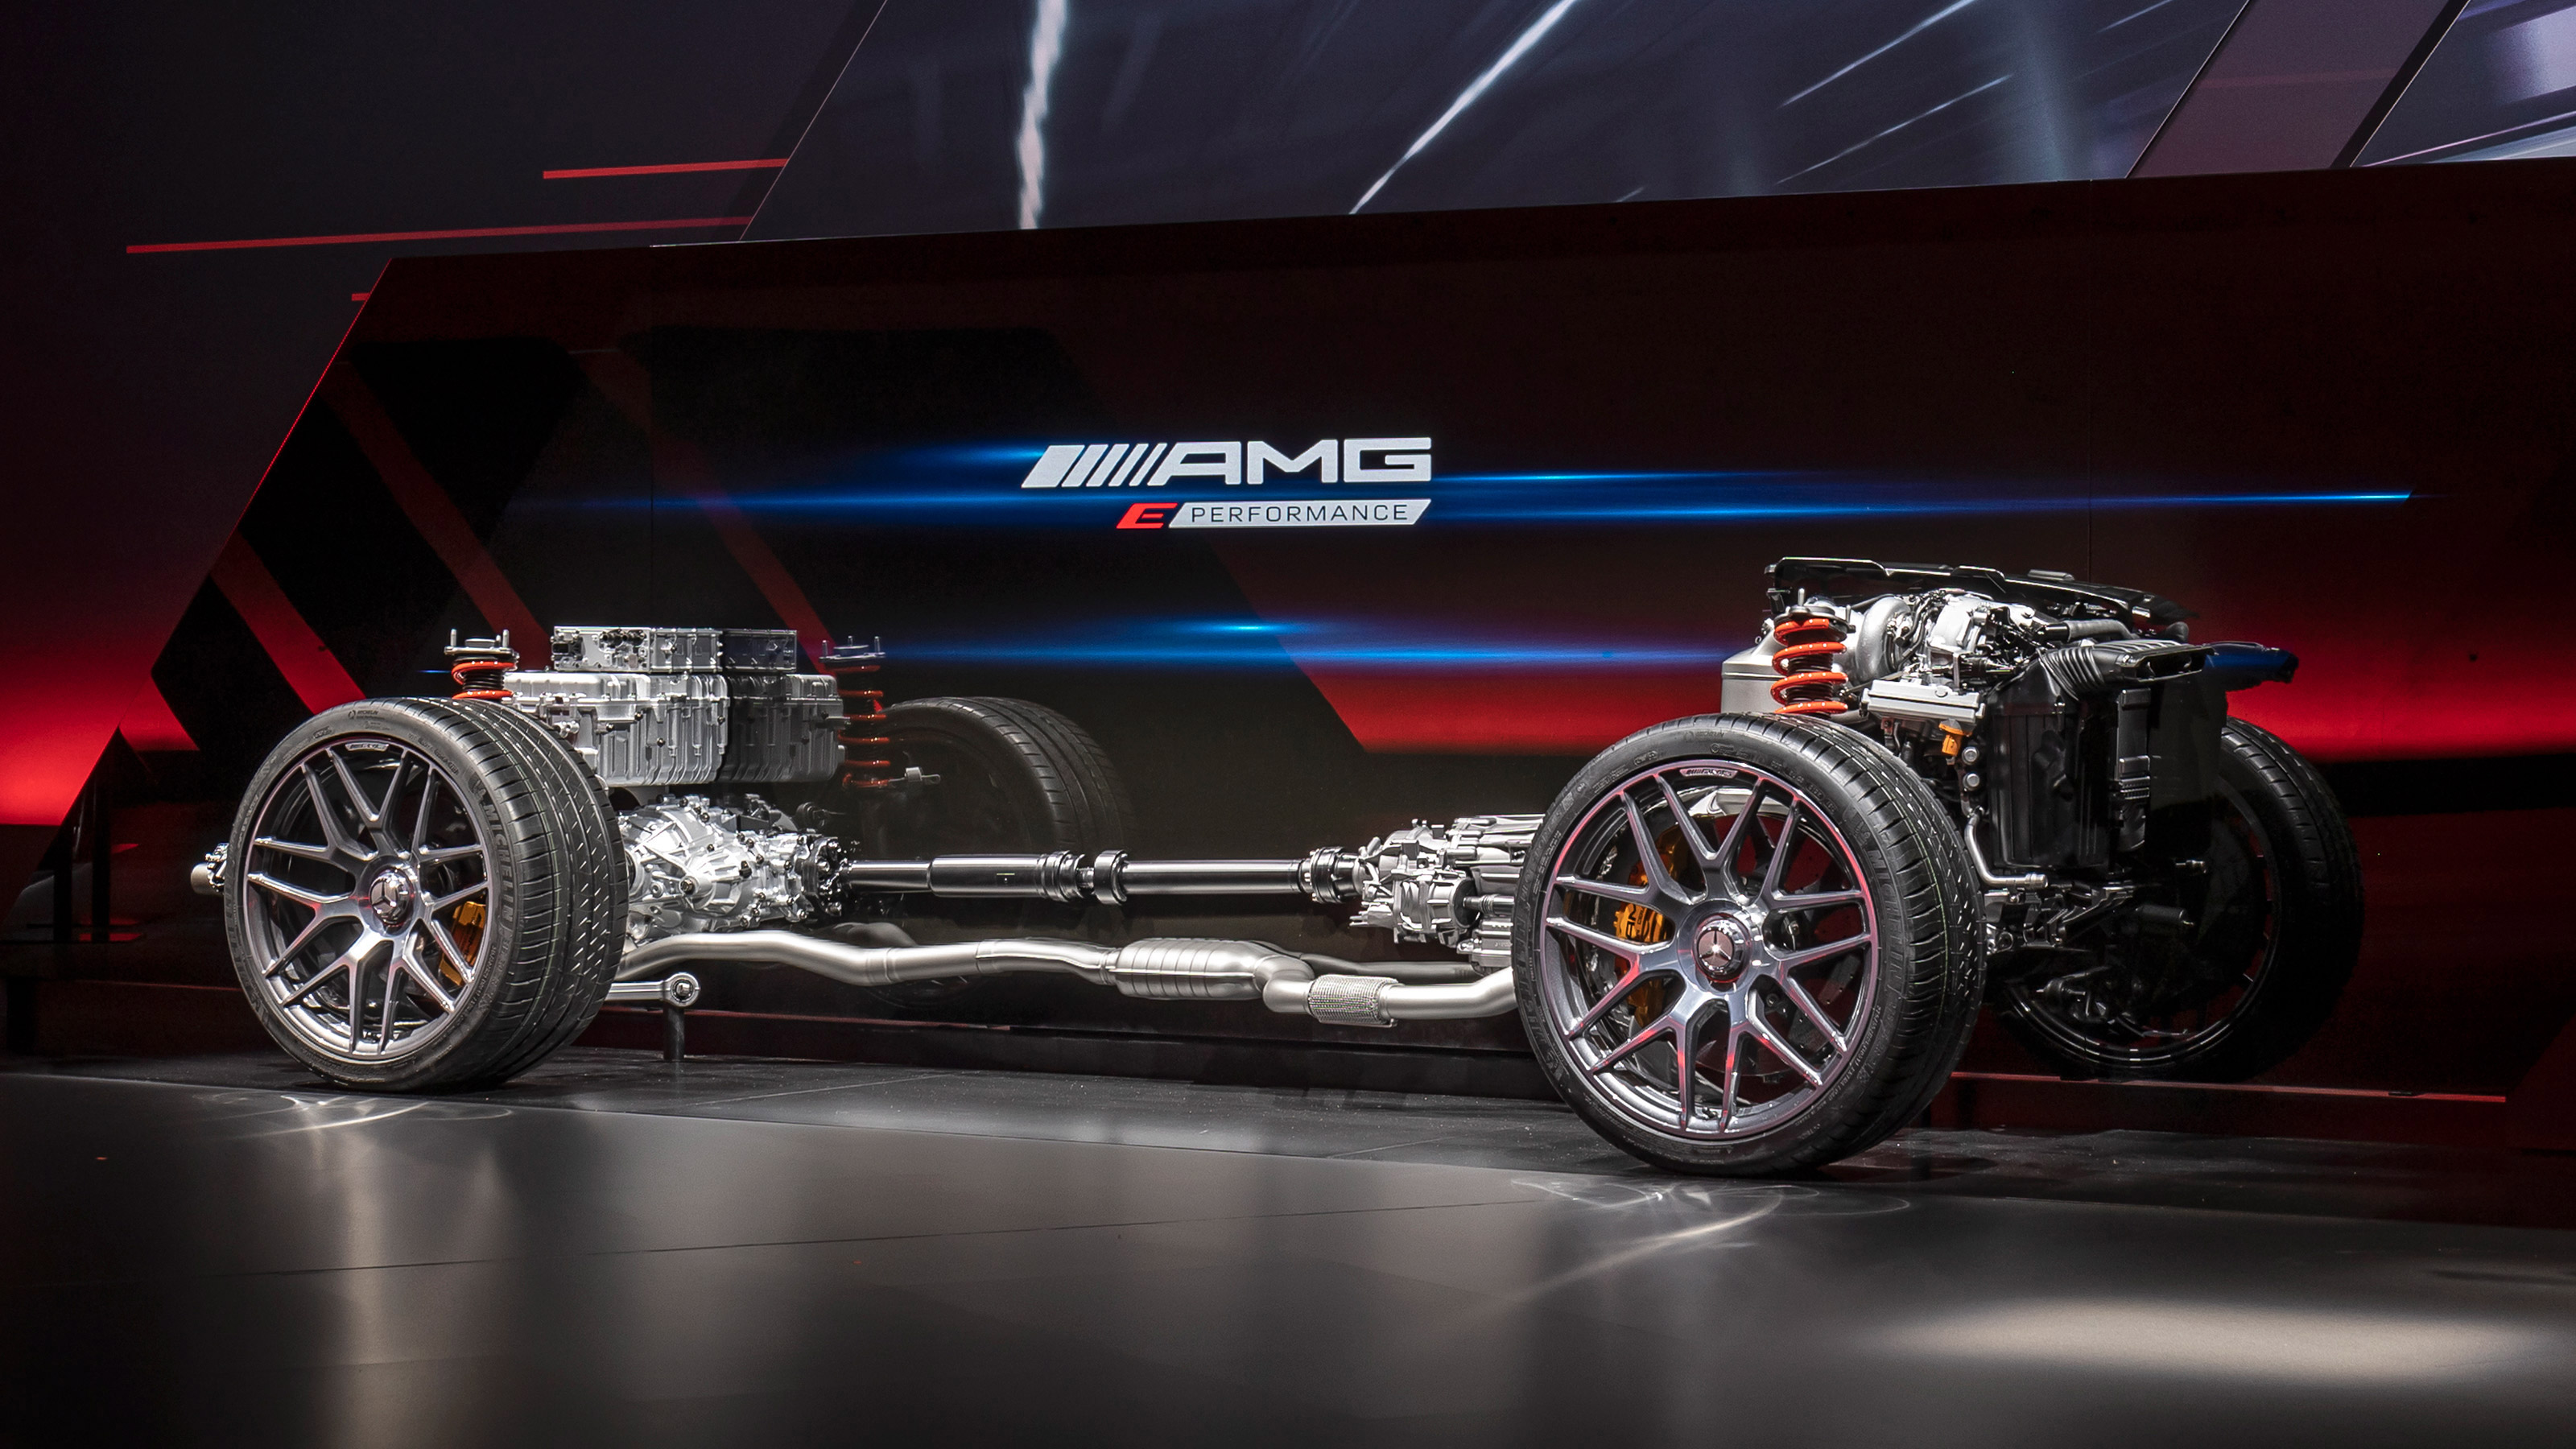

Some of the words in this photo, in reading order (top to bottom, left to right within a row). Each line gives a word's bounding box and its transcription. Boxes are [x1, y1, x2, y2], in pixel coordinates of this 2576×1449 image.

[1147, 437, 1432, 485] AMG
[1117, 502, 1179, 529] E
[1191, 504, 1409, 523] PERFORMANCE
[483, 803, 514, 923] MICHELIN
[1867, 849, 1904, 979] MICHELIN
